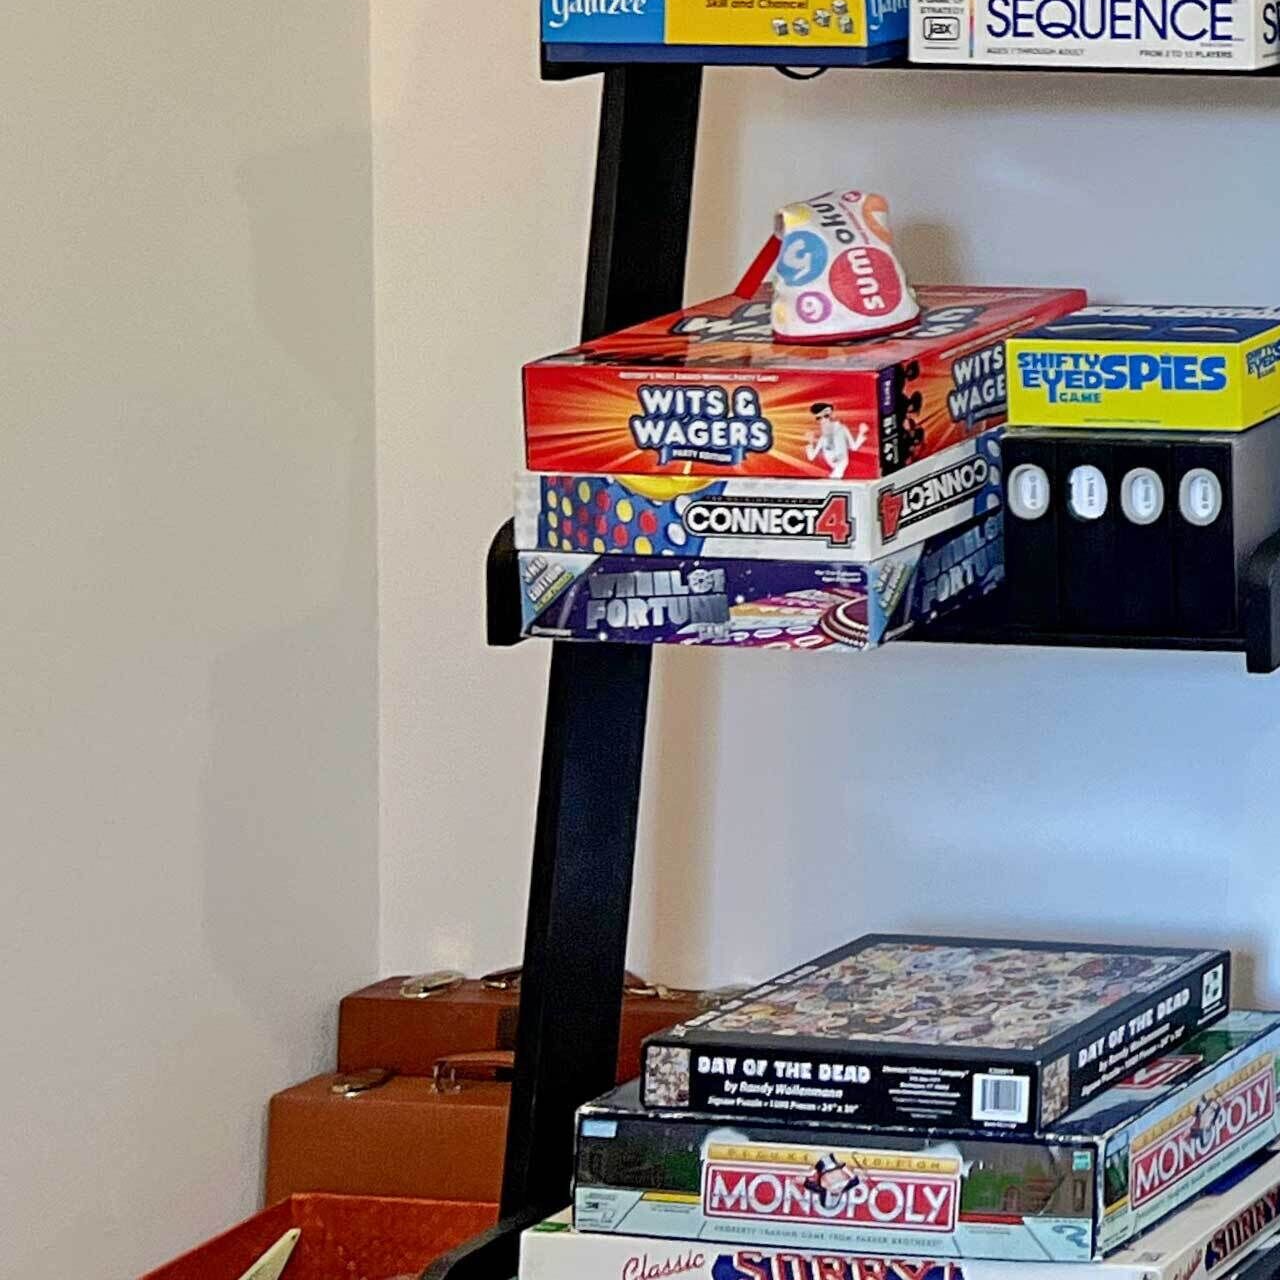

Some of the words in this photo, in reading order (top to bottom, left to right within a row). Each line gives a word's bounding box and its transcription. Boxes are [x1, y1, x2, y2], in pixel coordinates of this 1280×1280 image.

[926, 20, 953, 40] jax
[1195, 50, 1233, 59] PLAYERS
[953, 345, 1004, 385] WITS
[1016, 352, 1101, 370] SHIFTY
[1022, 369, 1101, 404] EYED
[1059, 392, 1102, 404] GAME
[640, 389, 726, 416] WITS
[734, 390, 757, 417] &
[632, 420, 769, 448] WAGERS
[672, 448, 699, 459] PARTY
[901, 458, 988, 518] CONNECT
[687, 506, 819, 535] CONNECT
[815, 496, 850, 543] 4
[586, 594, 732, 630] FORTUNE
[1078, 1037, 1106, 1068] DAY
[1108, 1024, 1127, 1049] OF
[1128, 1008, 1154, 1037] THE
[1156, 988, 1190, 1020] DEAD
[697, 1056, 737, 1075] DAY
[742, 1058, 768, 1077] OF
[773, 1060, 812, 1080] THE
[818, 1063, 872, 1084] DEAD
[723, 1079, 738, 1094] by
[739, 1081, 775, 1096] Randy
[1135, 1077, 1270, 1199] MONOPOLY
[710, 1171, 949, 1224] MONOPOLY
[801, 1231, 825, 1240] GAME
[829, 1233, 852, 1241] FROM
[622, 1249, 706, 1280] Classic
